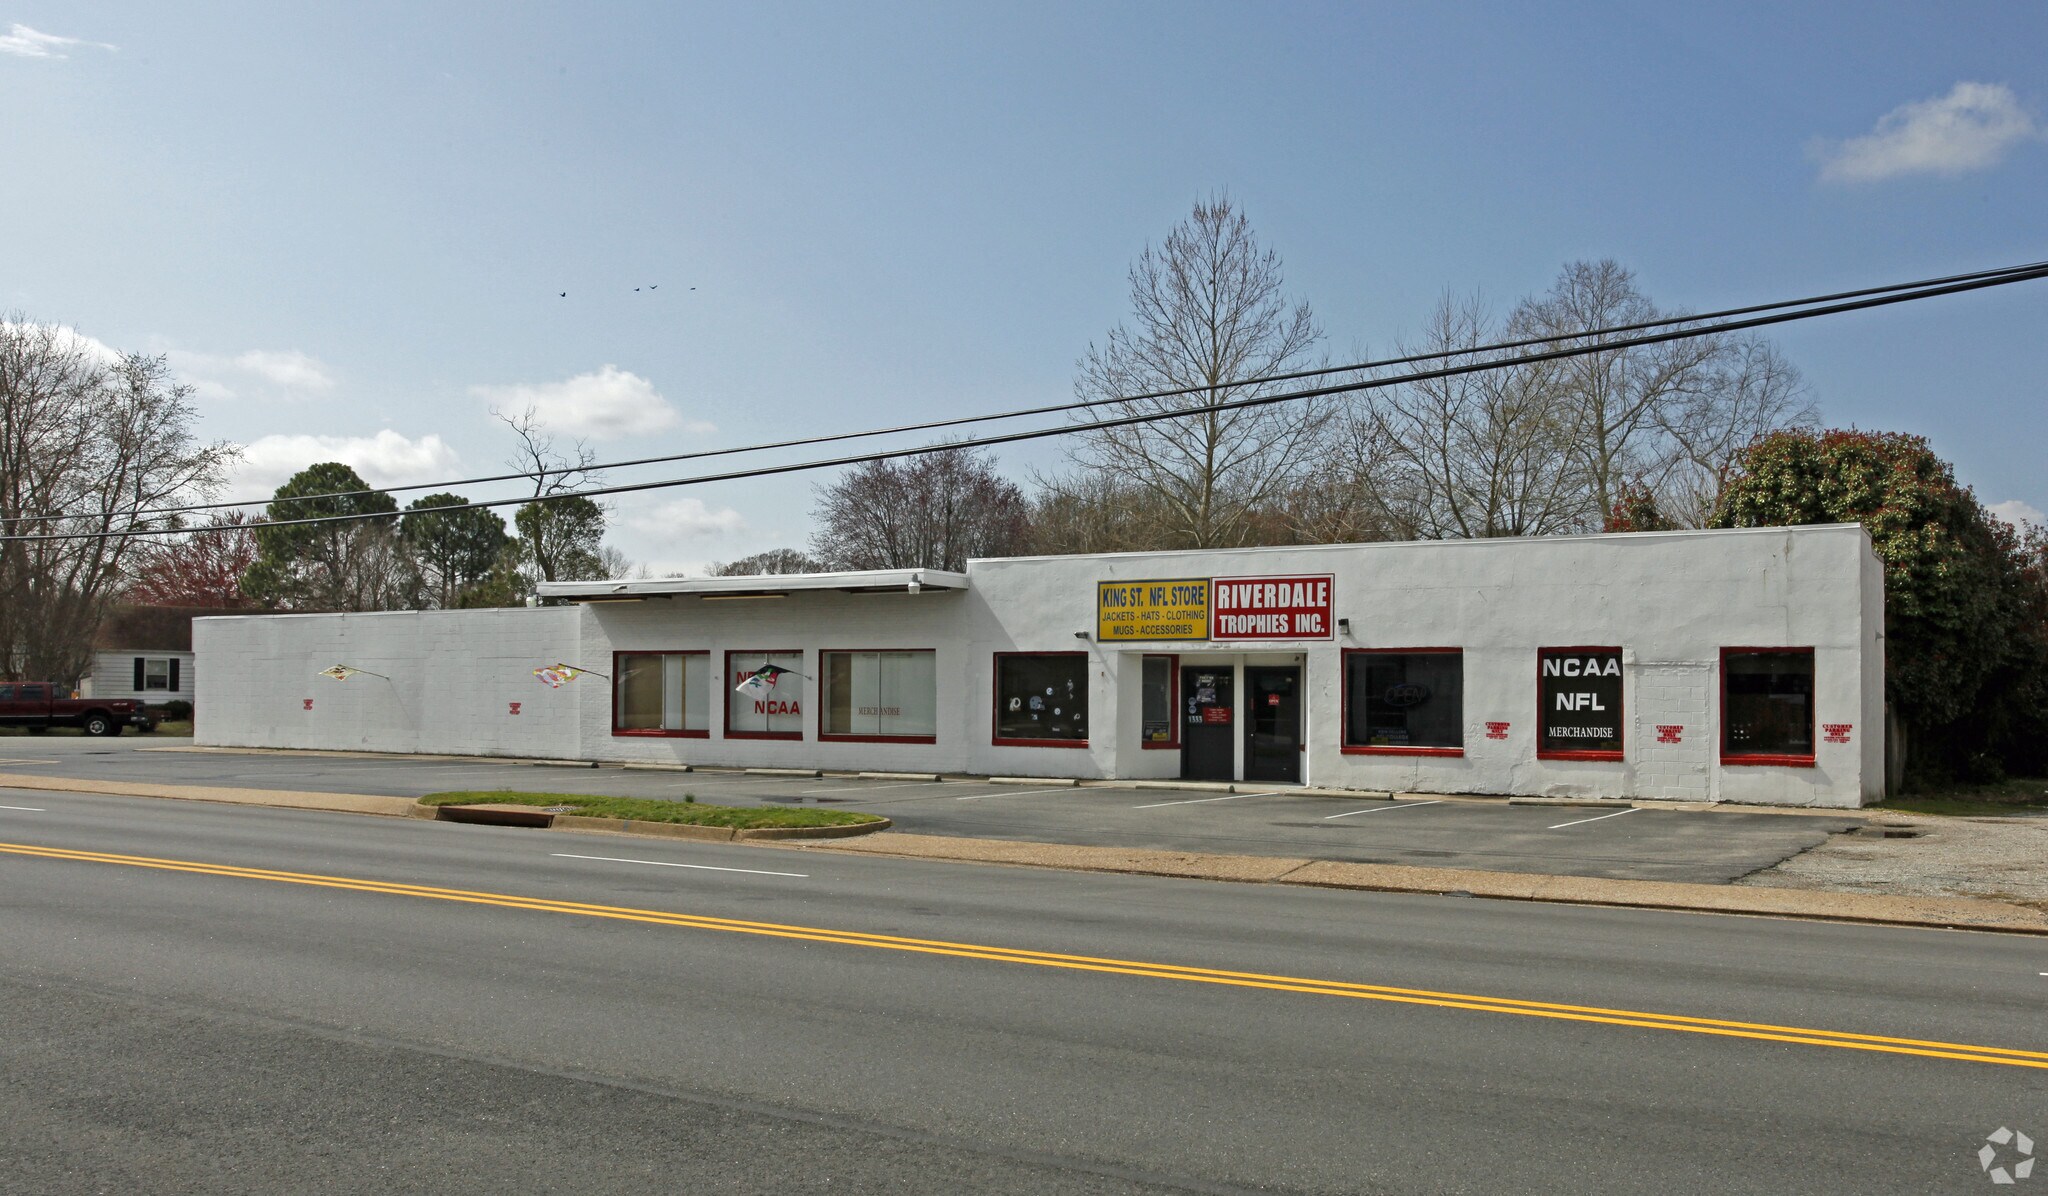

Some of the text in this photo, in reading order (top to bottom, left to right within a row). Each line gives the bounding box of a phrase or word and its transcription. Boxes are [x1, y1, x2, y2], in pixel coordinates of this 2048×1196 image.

[1103, 586, 1204, 607] KING ST. NFL STORE
[1218, 582, 1327, 609] RIVERDALE
[1103, 611, 1135, 621] JACKETS
[1141, 610, 1160, 620] HATS
[1166, 610, 1205, 620] CLOTHING
[1219, 613, 1325, 634] TROPHIES INC.
[1113, 625, 1135, 635] MUGS
[1140, 624, 1193, 635] ACCESSORIES
[1543, 658, 1621, 677] NCAA
[755, 700, 800, 715] NCAA
[1556, 692, 1605, 711] NFL
[858, 706, 900, 716] MERCHANDISE
[1549, 726, 1613, 738] MERCHANDISE
